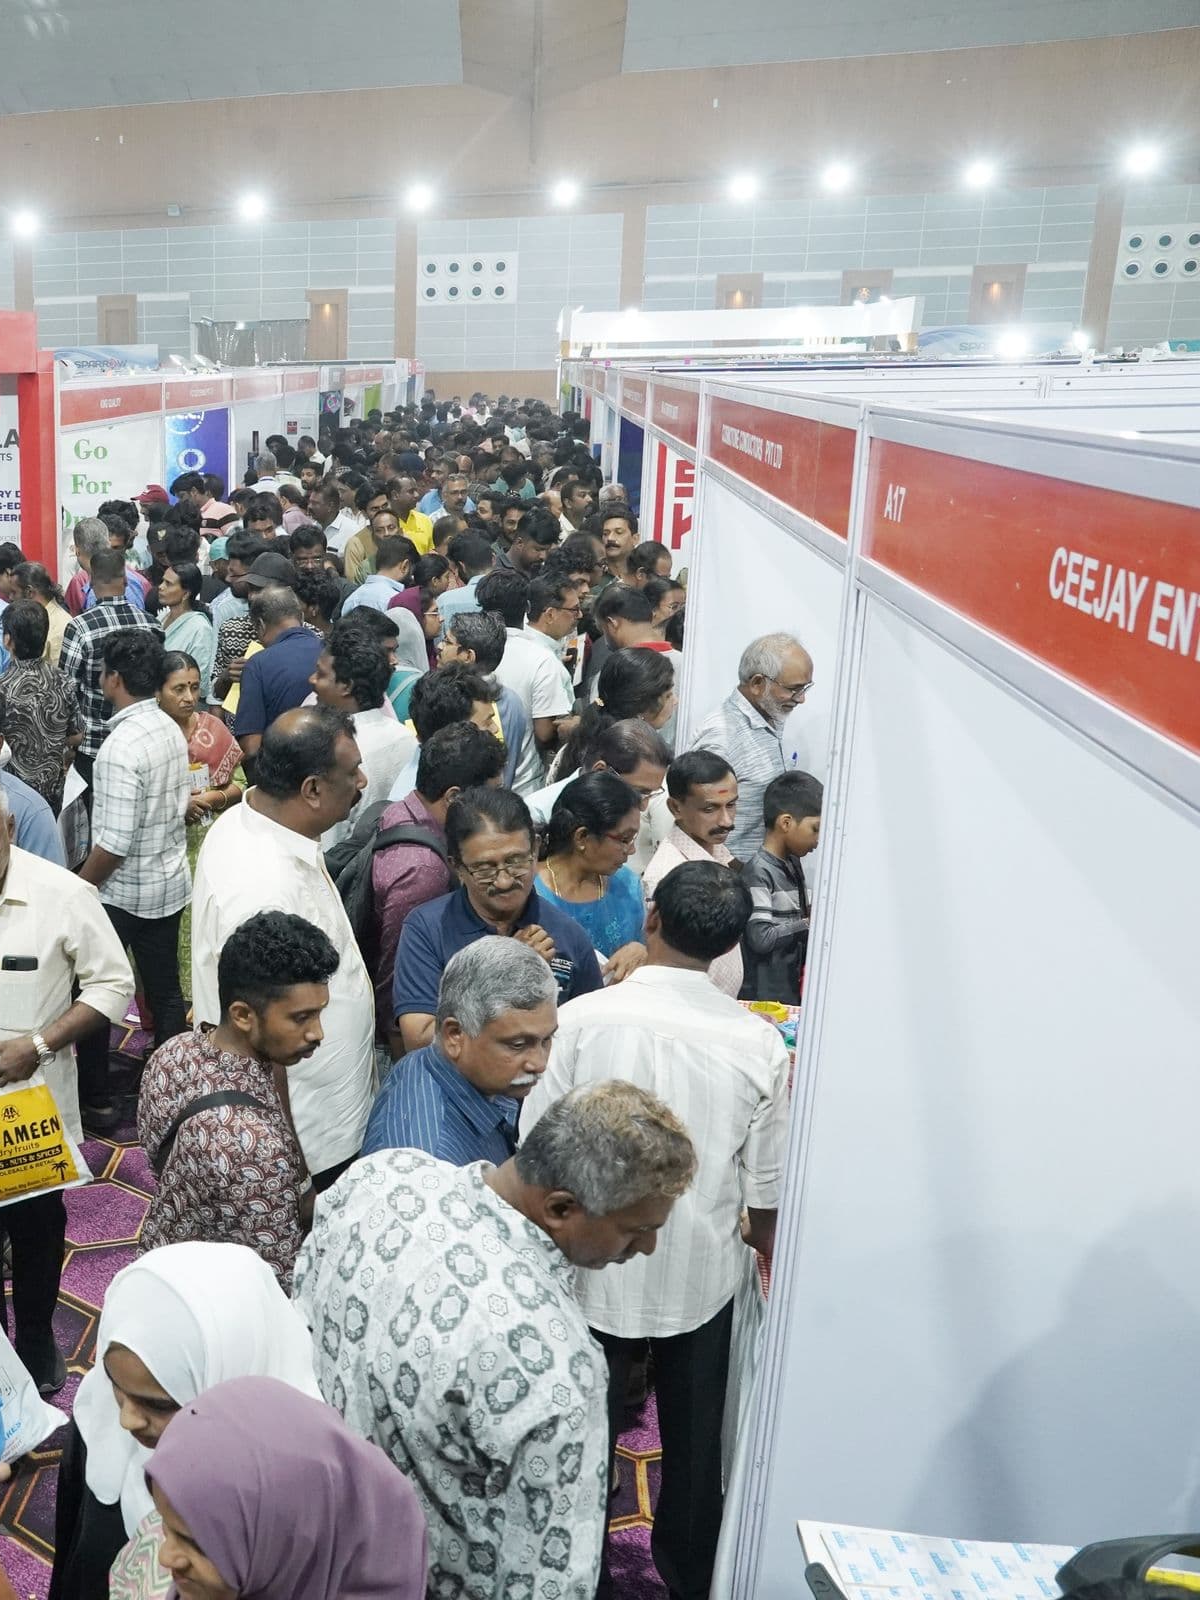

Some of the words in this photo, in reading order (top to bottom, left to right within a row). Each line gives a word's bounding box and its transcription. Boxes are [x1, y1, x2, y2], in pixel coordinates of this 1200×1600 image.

[74, 359, 127, 369] SPARROW
[73, 439, 108, 460] Go
[71, 473, 112, 495] For
[883, 483, 907, 523] A17
[1049, 546, 1149, 634] CEEJAY
[10, 1156, 28, 1167] NUTS
[36, 1147, 61, 1160] SPICES
[14, 1141, 40, 1153] fruits
[35, 1159, 56, 1169] RETAIL
